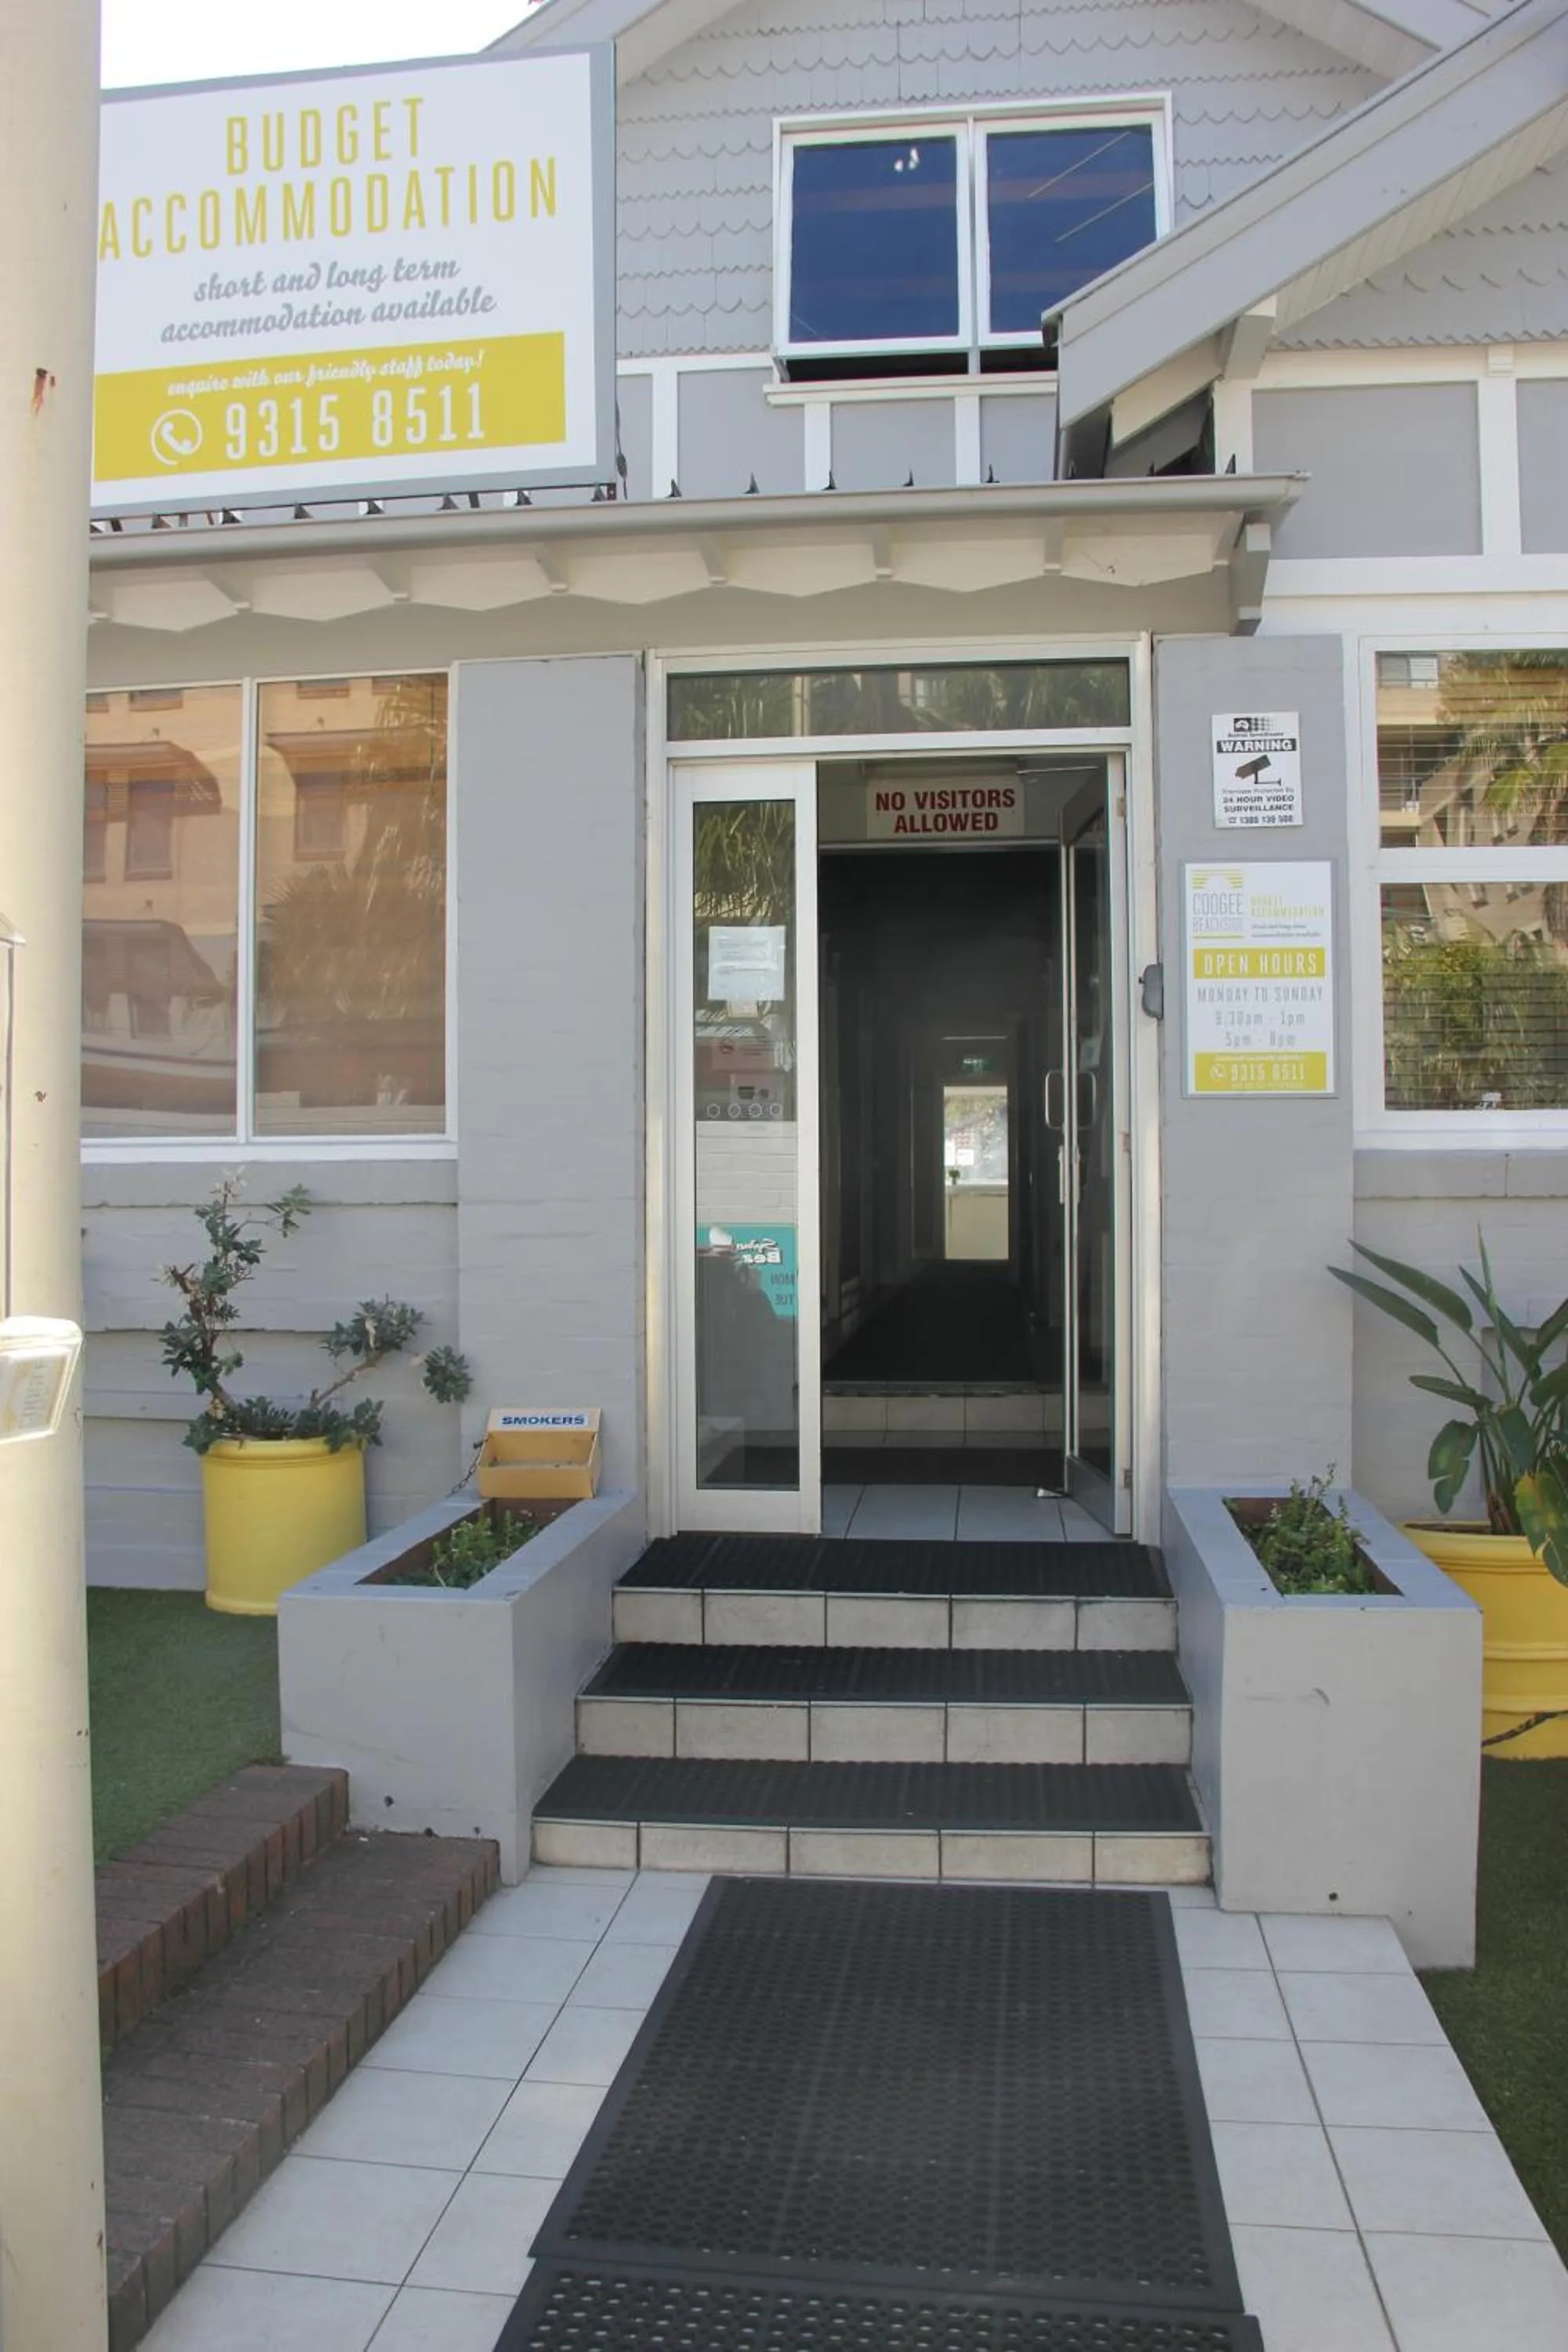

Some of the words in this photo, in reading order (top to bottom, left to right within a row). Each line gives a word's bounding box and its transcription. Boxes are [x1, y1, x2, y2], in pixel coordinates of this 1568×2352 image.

[226, 97, 424, 176] BUDGET
[99, 156, 557, 261] ACCOMMODATION
[194, 270, 267, 303] short
[271, 263, 321, 295] and
[326, 261, 386, 293] long
[393, 258, 460, 282] term
[161, 301, 367, 343] accommodation
[371, 286, 497, 322] available
[168, 376, 228, 400] enquire
[232, 368, 268, 390] with
[274, 370, 303, 385] our
[306, 360, 376, 388] friendly
[379, 354, 423, 379] staff
[225, 393, 339, 459] 9315
[372, 382, 485, 447] 8511
[1221, 740, 1293, 752] WARNING
[875, 792, 906, 811] NO
[914, 789, 1016, 810] VISITORS
[1224, 804, 1294, 813] SURVEILLANCE
[894, 812, 999, 833] ALLOWED
[1192, 892, 1243, 916] COOGEE
[1204, 953, 1248, 975] OPEN
[1261, 953, 1317, 975] HOURS
[1197, 986, 1248, 1003] MONDAY
[1254, 986, 1268, 1002] TO
[1275, 986, 1323, 1003] SUNDAY
[502, 1416, 586, 1425] SMOKERS
